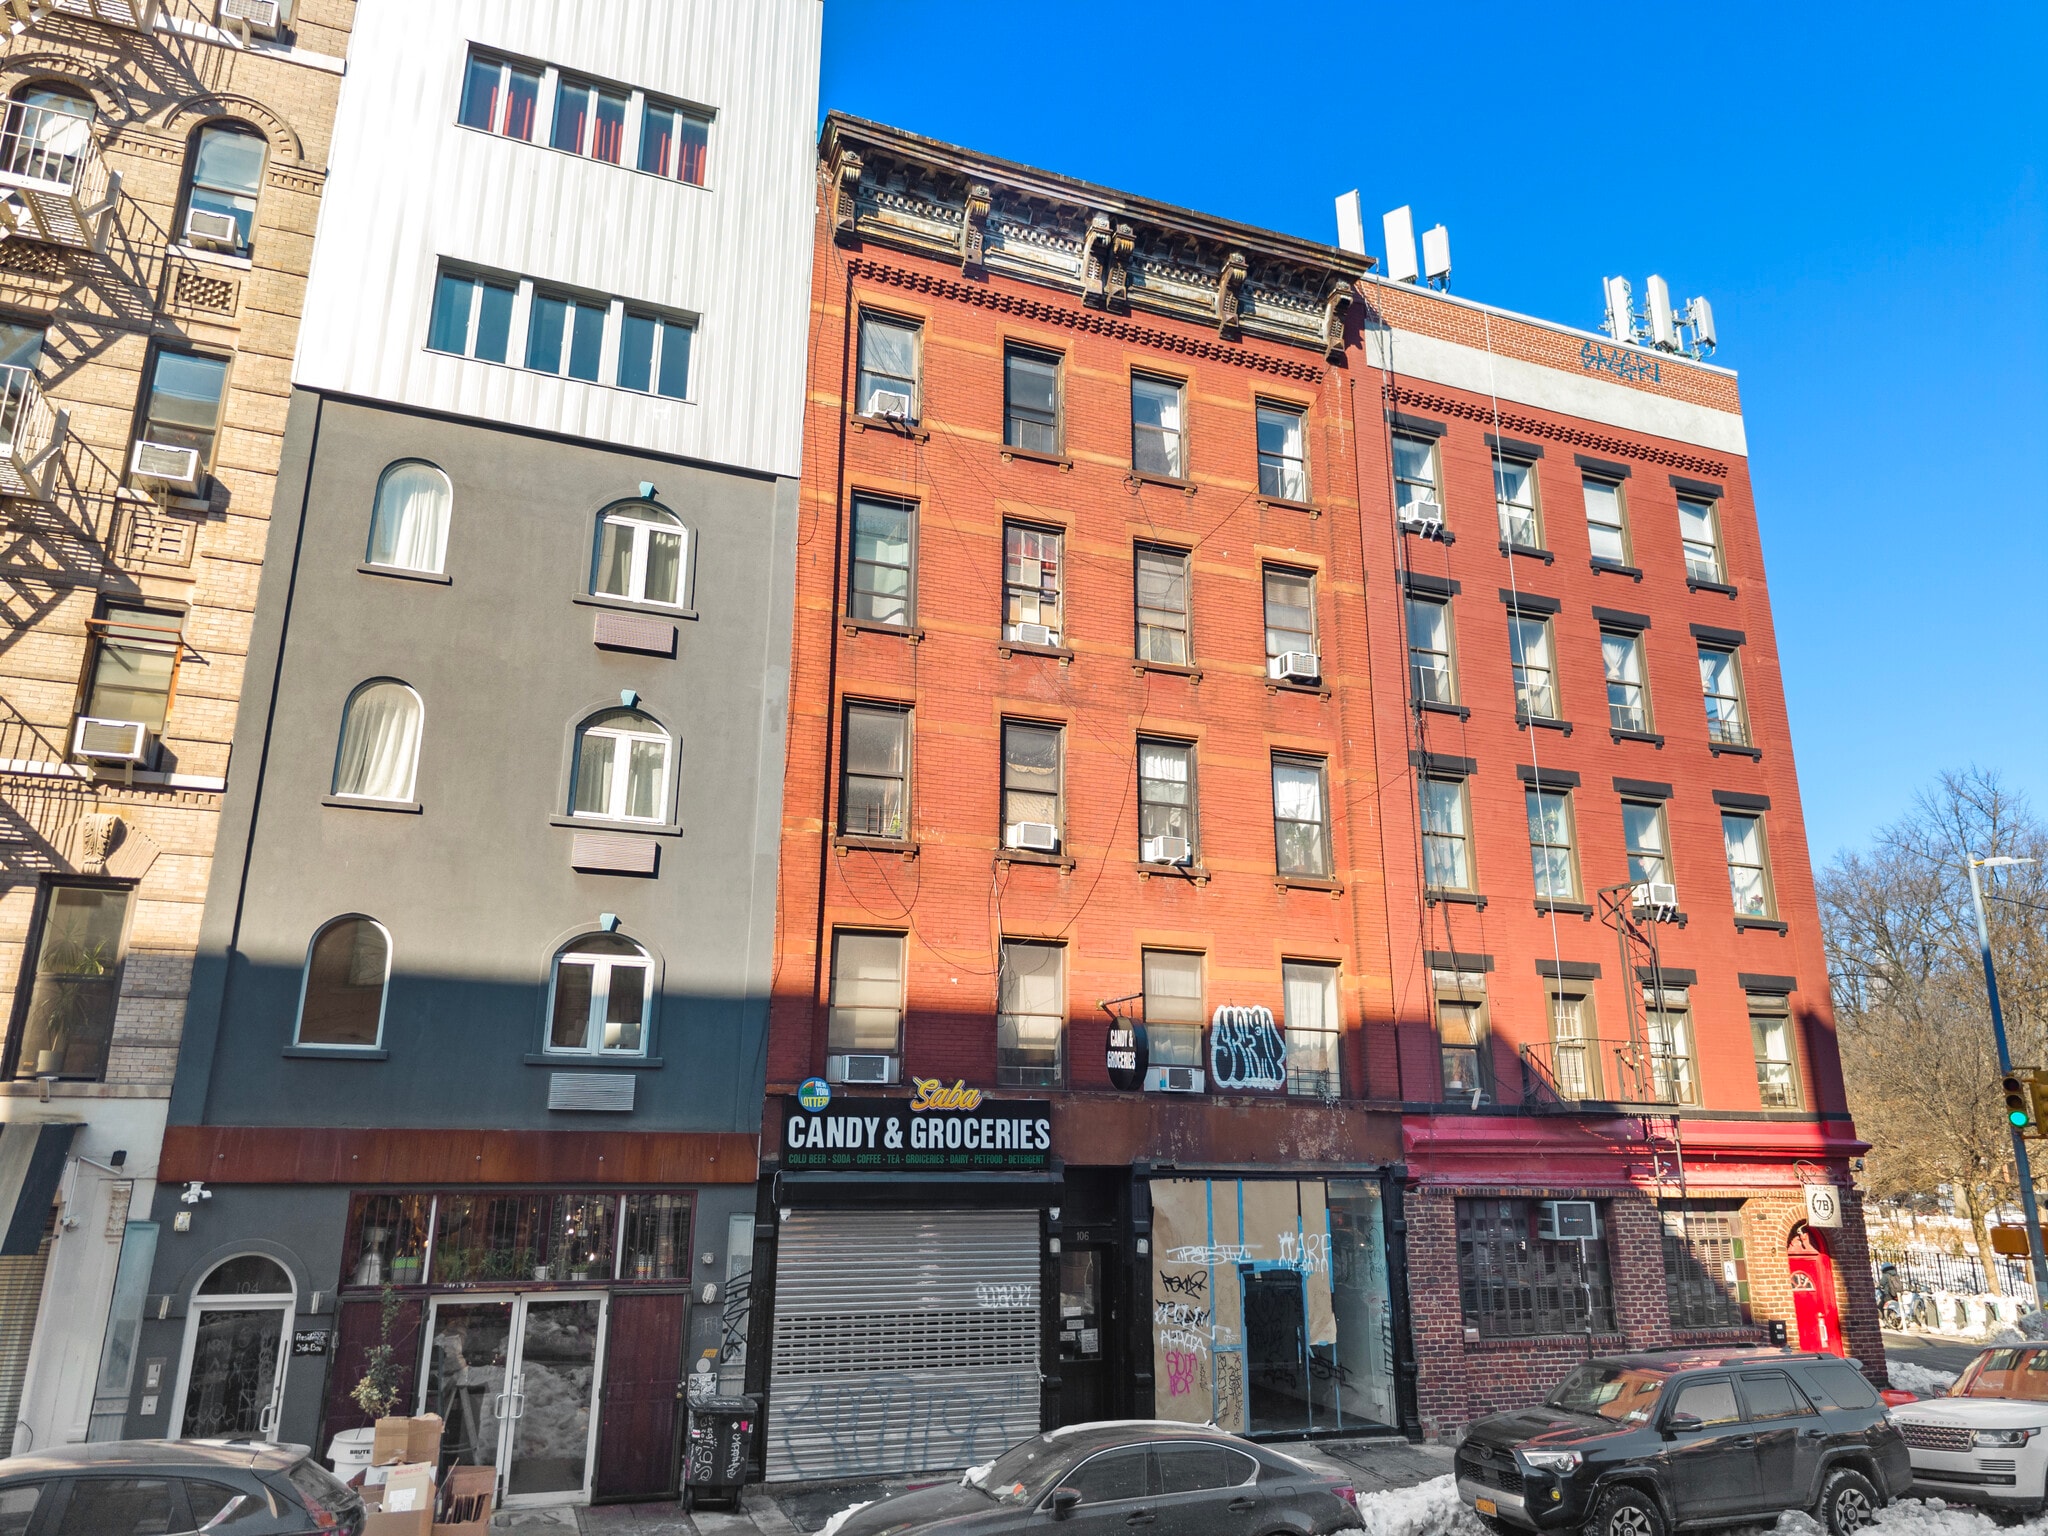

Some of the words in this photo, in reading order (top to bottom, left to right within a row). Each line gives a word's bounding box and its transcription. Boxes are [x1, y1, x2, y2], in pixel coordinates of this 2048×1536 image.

[1110, 1029, 1128, 1047] CANDY
[1128, 1029, 1134, 1047] &
[1107, 1050, 1136, 1070] GROCERIES
[910, 1076, 982, 1111] Saba
[788, 1115, 880, 1149] CANDY
[883, 1117, 904, 1149] &
[910, 1117, 1051, 1150] GROCERIES
[788, 1153, 806, 1164] COLD
[808, 1153, 827, 1164] BEER
[832, 1153, 851, 1164] SODA
[856, 1153, 881, 1164] COFFEE
[887, 1153, 900, 1164] TEA
[949, 1153, 969, 1164] DAIRY
[1008, 1153, 1045, 1164] DETERGENT
[1816, 1199, 1830, 1211] 7B
[1076, 1230, 1089, 1241] 106
[1726, 1265, 1734, 1276] A
[235, 1281, 260, 1294] 104
